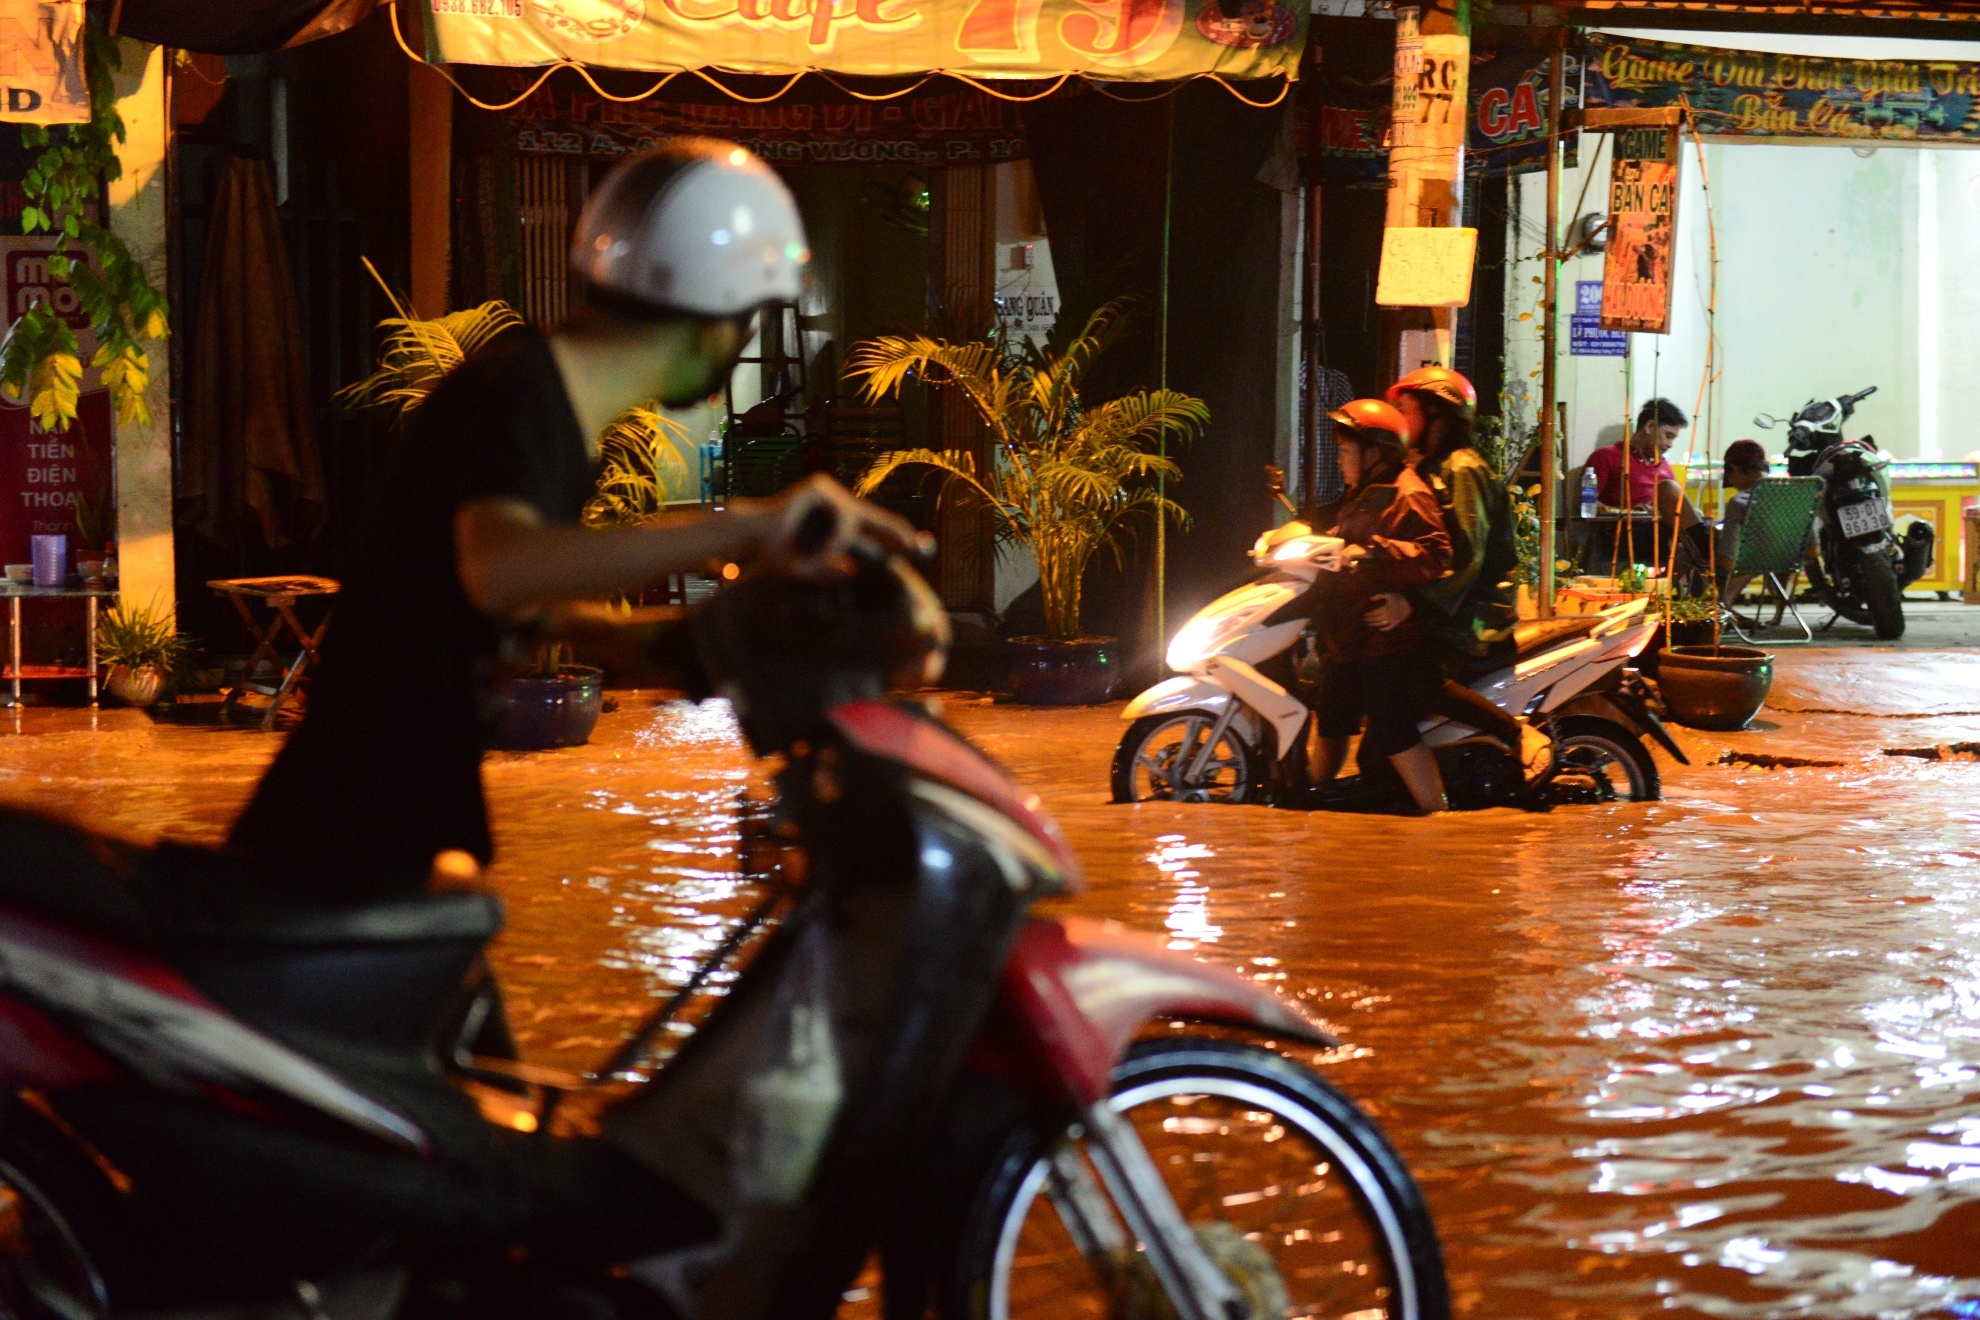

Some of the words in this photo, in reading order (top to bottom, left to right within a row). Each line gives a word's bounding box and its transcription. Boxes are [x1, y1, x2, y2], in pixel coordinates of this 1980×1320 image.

[1418, 58, 1458, 92] RC
[1601, 45, 1694, 90] Game
[0, 86, 42, 113] D
[1478, 68, 1542, 137] CÁ
[1624, 128, 1668, 159] GAME
[1650, 176, 1670, 212] CÁ
[26, 463, 76, 486] ĐIỆN
[20, 491, 85, 510] THOẠ
